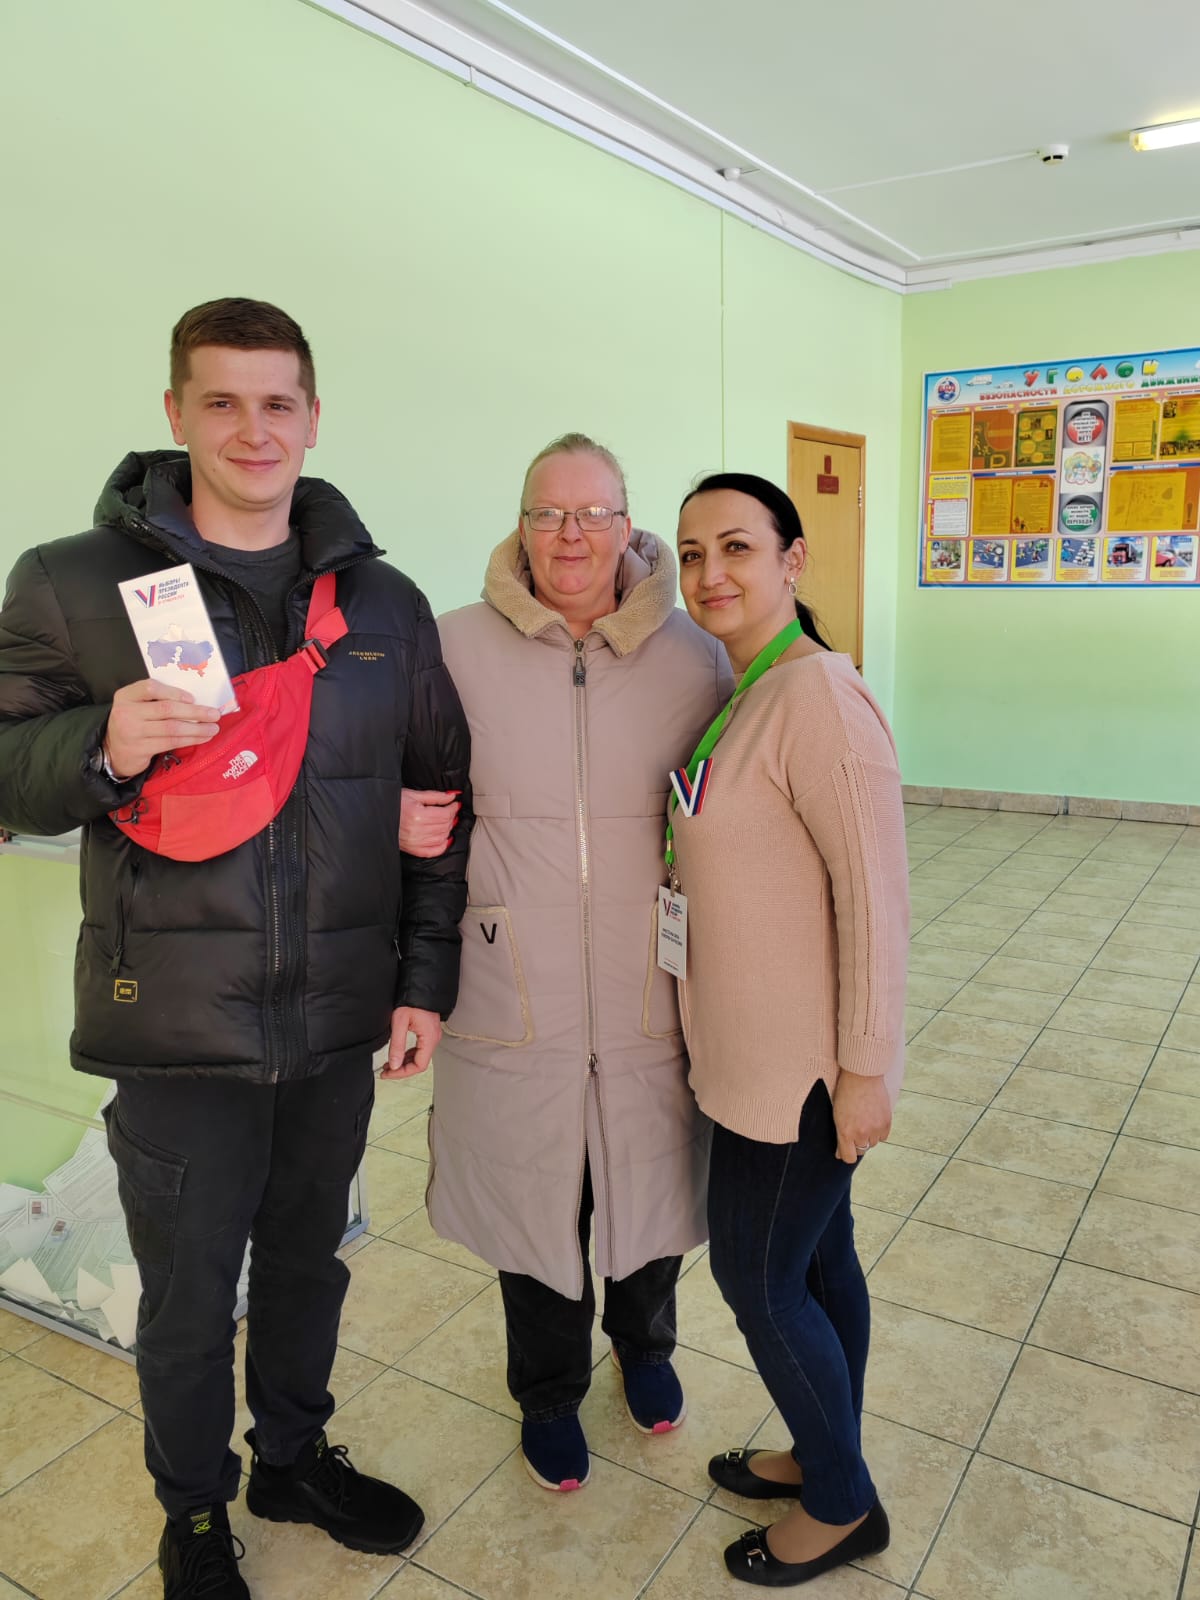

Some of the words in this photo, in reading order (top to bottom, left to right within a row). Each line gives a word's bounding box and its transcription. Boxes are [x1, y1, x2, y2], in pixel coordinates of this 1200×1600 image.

[1023, 359, 1159, 387] УГОЛОК
[980, 388, 1057, 401] БЕЗОПАСНОСТИ
[1141, 375, 1200, 388] ДВИЖЕНИ
[479, 922, 497, 944] V
